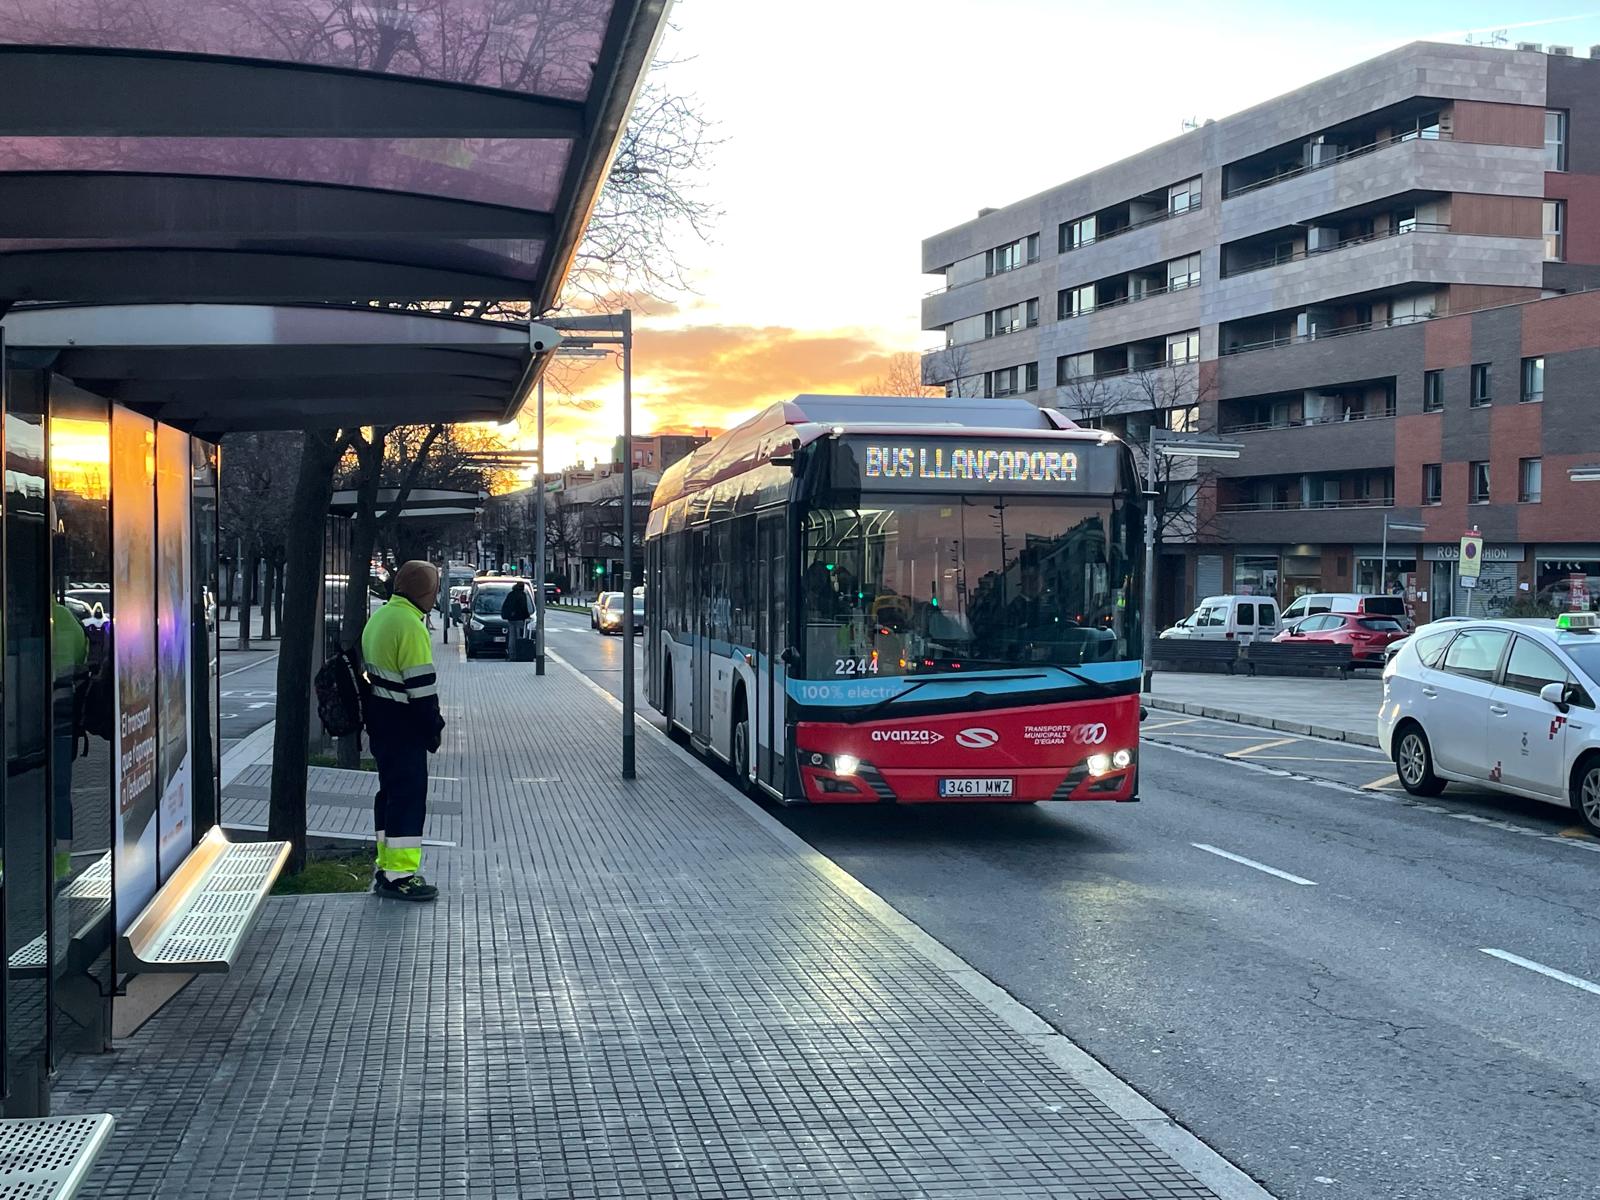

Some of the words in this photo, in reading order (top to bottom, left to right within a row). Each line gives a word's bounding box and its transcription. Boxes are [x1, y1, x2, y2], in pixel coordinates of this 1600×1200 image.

[866, 447, 913, 477] BUS
[919, 448, 1078, 482] LLANÇADORA
[835, 659, 878, 674] 2244
[802, 685, 844, 699] 100%
[127, 705, 151, 734] transport
[871, 730, 930, 741] avanza
[1023, 731, 1068, 739] MUNICIPALS
[121, 748, 133, 777] que
[948, 780, 980, 793] 3461
[985, 780, 1010, 793] MWZ
